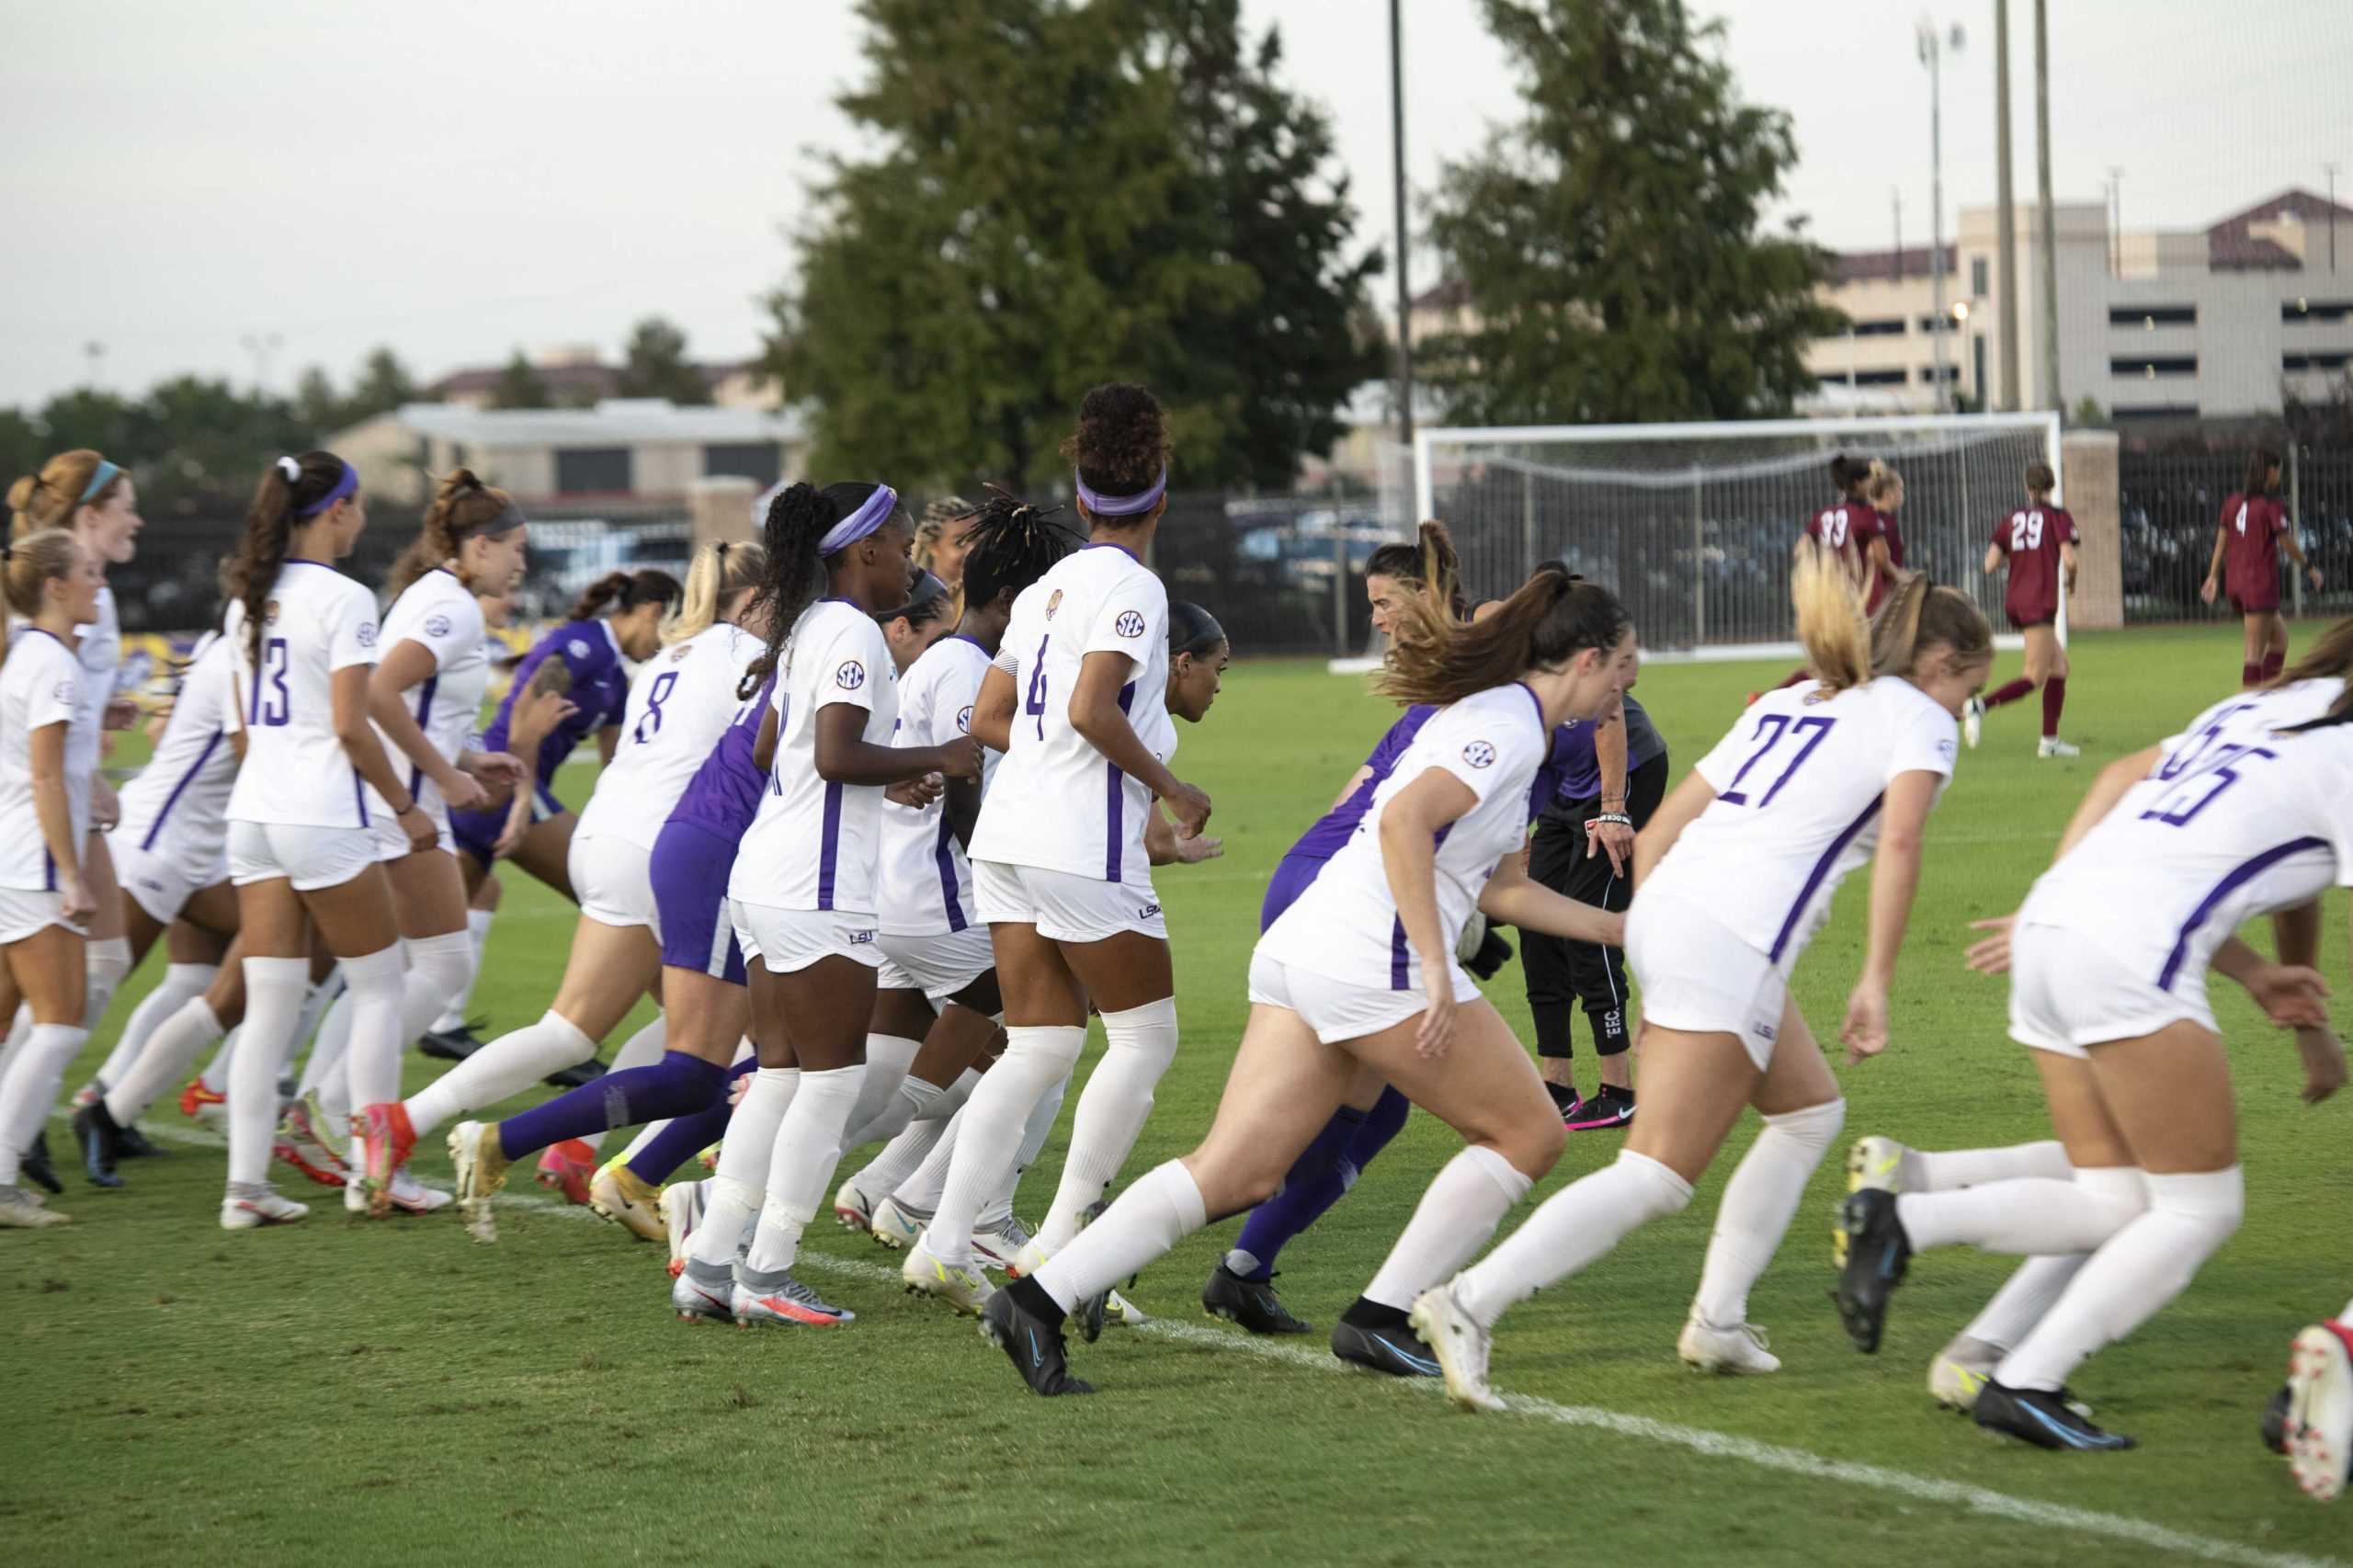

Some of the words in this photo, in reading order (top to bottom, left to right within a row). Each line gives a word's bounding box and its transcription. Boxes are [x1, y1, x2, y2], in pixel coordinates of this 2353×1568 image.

[2011, 511, 2043, 551] 29
[2235, 500, 2248, 538] 4
[1116, 610, 1145, 638] SEC
[247, 638, 290, 726] 13
[836, 661, 864, 689] SEC
[1027, 634, 1050, 741] 4
[634, 671, 679, 744] 8
[1717, 714, 1836, 809] 27
[849, 930, 873, 945] LSU
